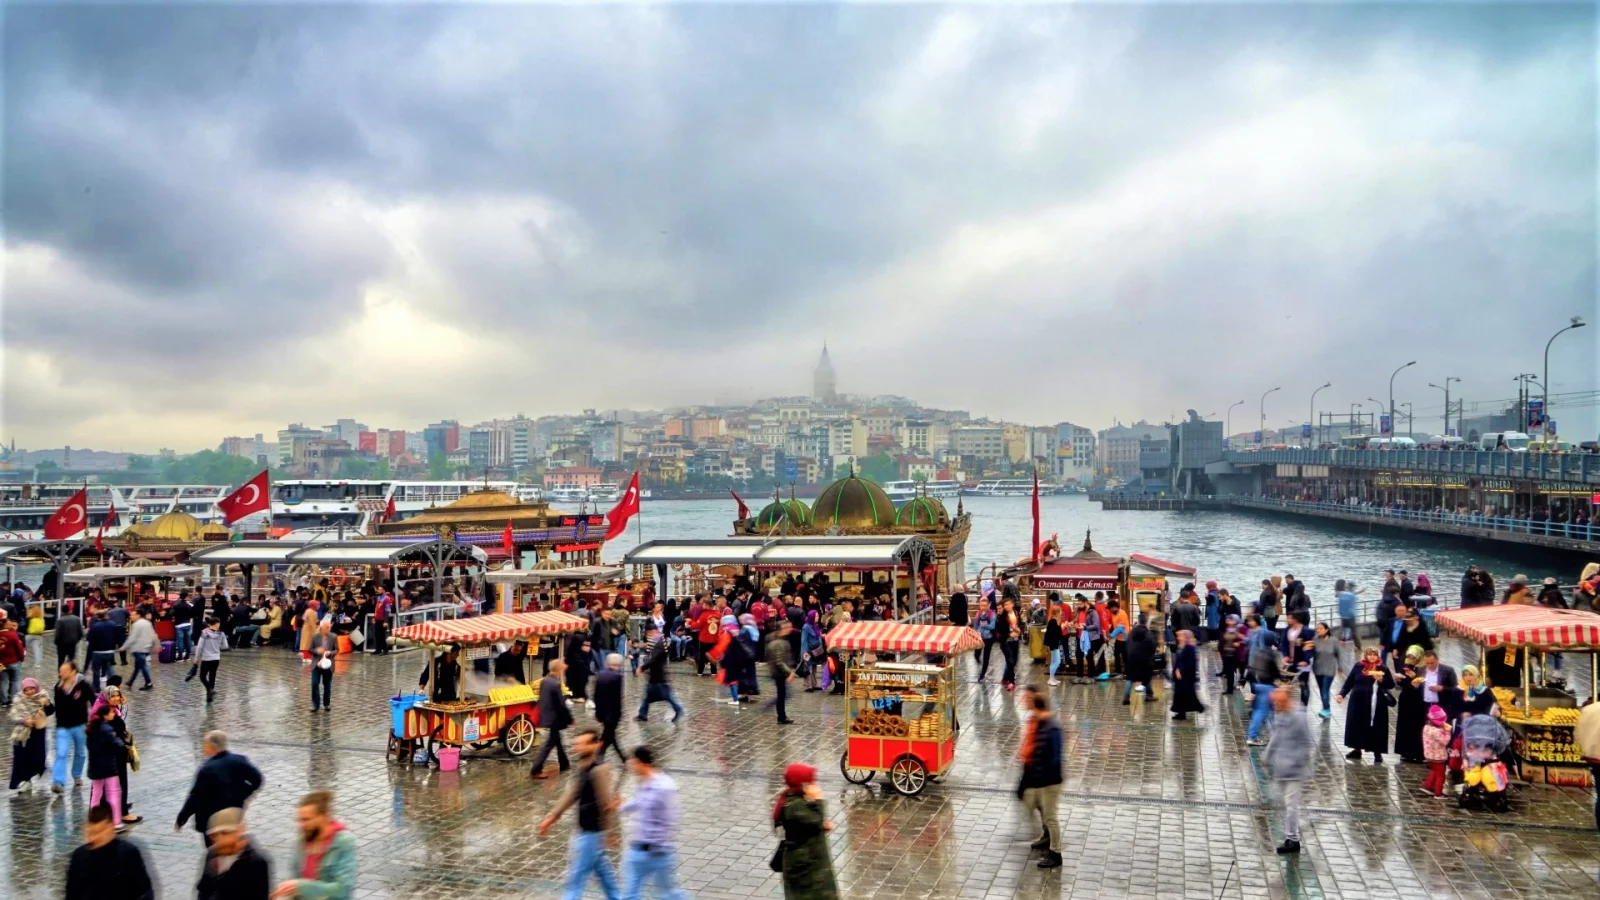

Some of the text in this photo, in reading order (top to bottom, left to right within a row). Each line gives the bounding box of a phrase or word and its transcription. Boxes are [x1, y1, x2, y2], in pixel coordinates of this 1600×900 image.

[1077, 580, 1114, 589] Lokması
[1531, 742, 1583, 752] KESTAN
[1539, 752, 1582, 762] KEBAP
